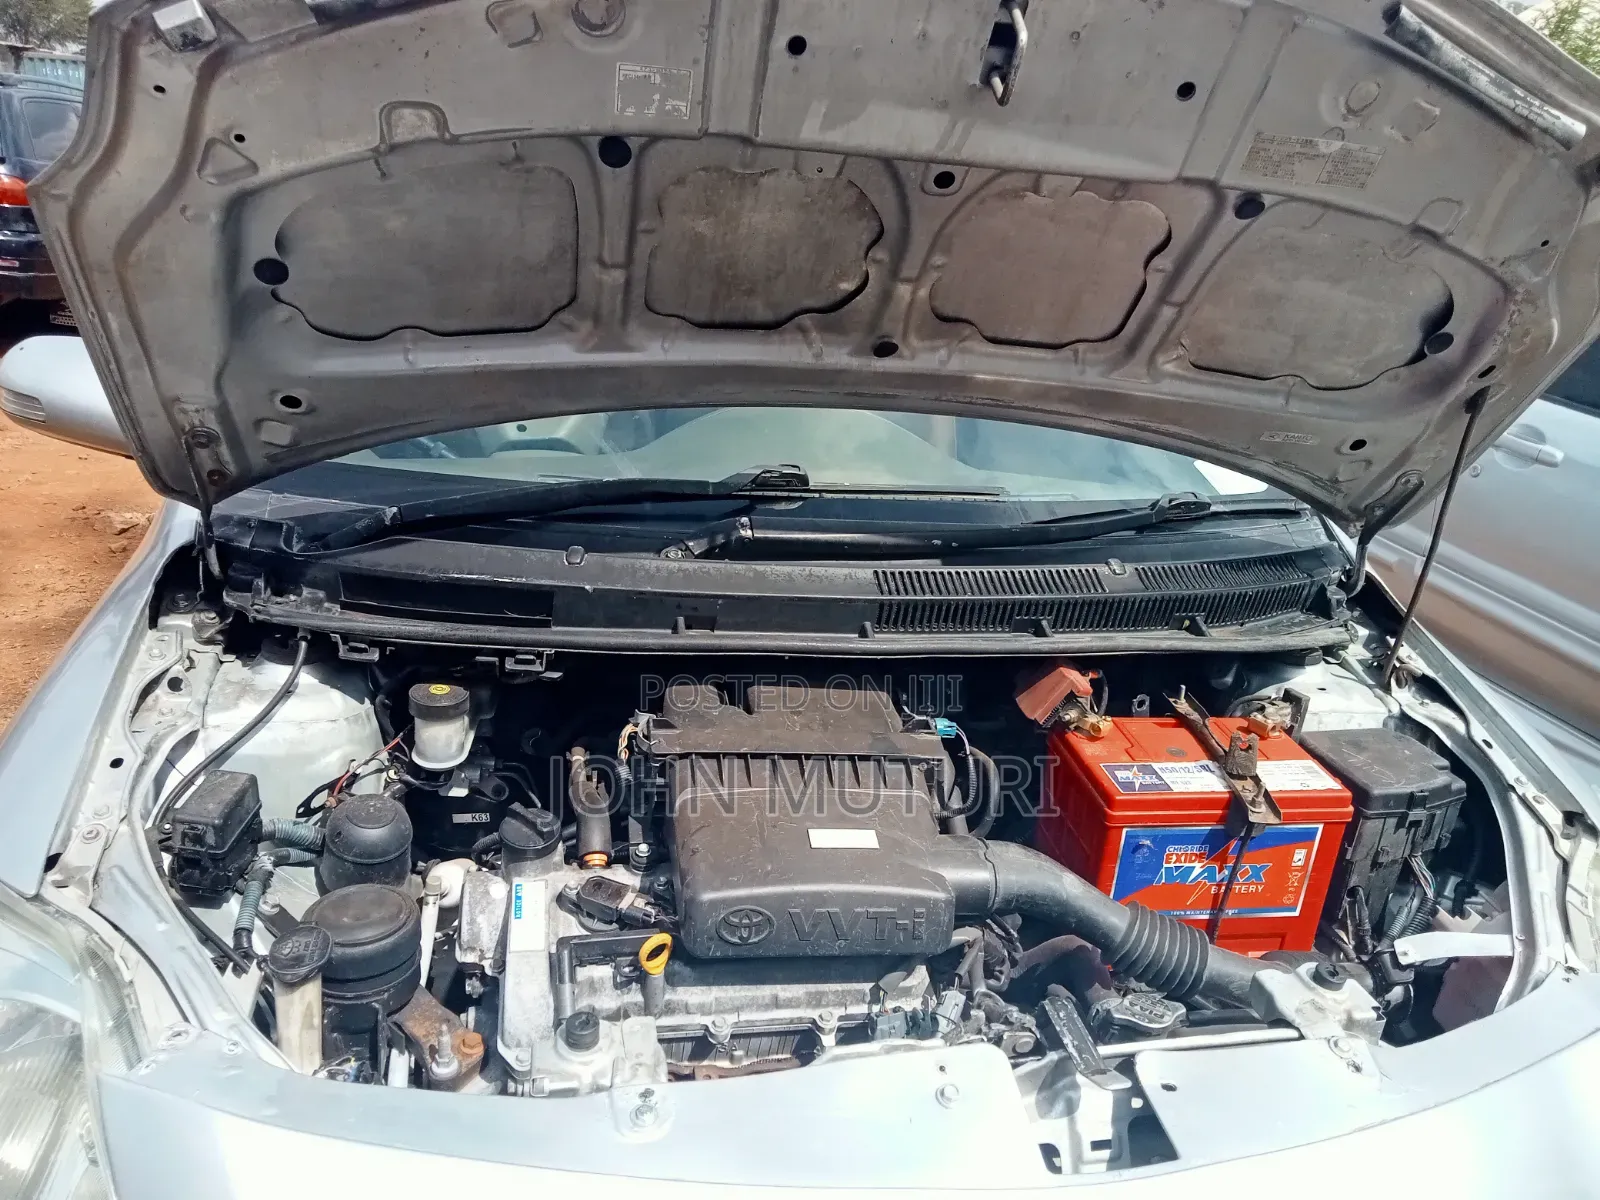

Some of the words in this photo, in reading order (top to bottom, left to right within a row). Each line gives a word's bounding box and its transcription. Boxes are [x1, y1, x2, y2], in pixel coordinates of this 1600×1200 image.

[471, 813, 489, 822] K63
[1166, 845, 1209, 853] CHLORIDE
[1164, 853, 1207, 865] EXIDE
